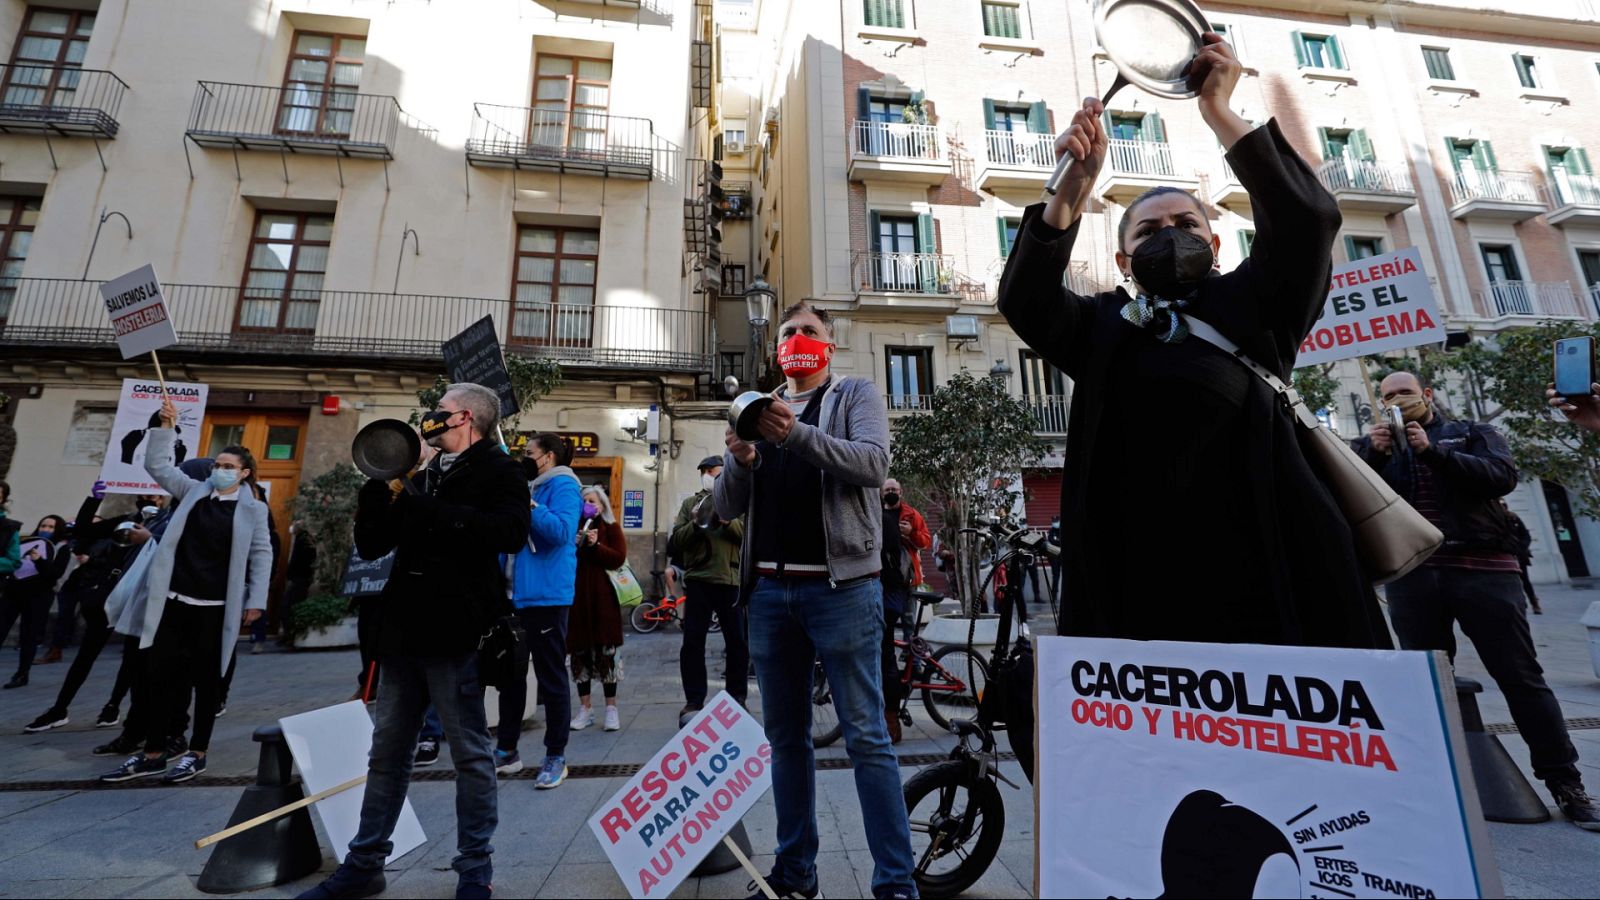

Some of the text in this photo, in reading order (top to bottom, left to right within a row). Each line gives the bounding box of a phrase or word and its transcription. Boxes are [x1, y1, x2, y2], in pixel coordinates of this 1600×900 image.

[1329, 257, 1418, 291] TELERÍA
[106, 281, 158, 313] SALVEMOS LA
[1331, 292, 1367, 316] ES
[1372, 284, 1409, 307] EL
[1300, 308, 1436, 353] ROBLEMA
[133, 384, 199, 396] CACEOLADA
[1071, 660, 1385, 730] CACEROLADA
[1071, 699, 1398, 772] OCIO Y HOSTELERÍA
[600, 699, 742, 845] RESCATE
[638, 741, 740, 848] PARA LOS
[638, 743, 772, 896] AUTÓNOMOS
[1293, 810, 1371, 845] SIN AYUDAS
[1314, 856, 1359, 874] ERTES
[1318, 871, 1353, 888] ICOS
[1361, 872, 1436, 899] TRAMPA
